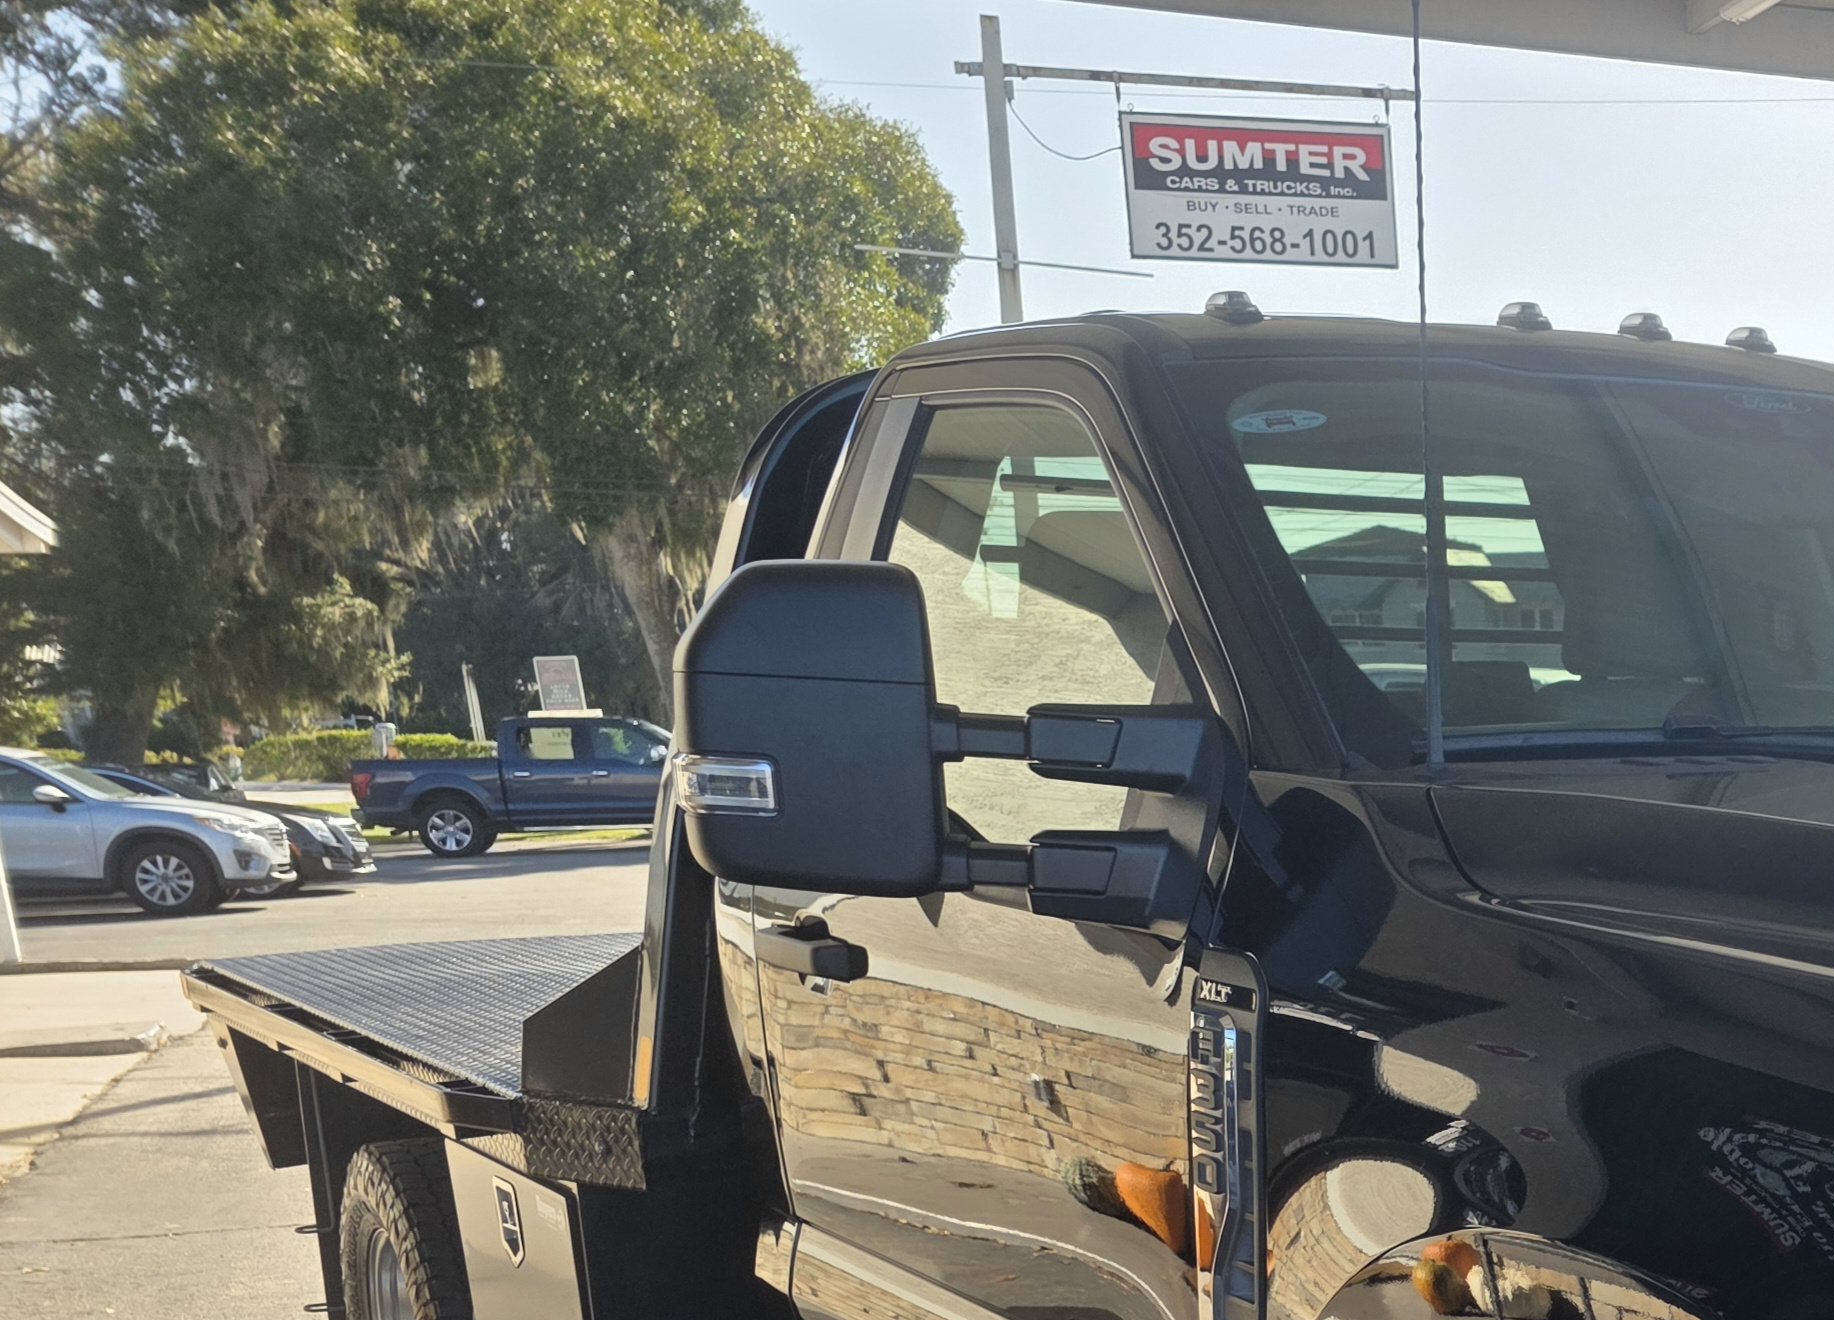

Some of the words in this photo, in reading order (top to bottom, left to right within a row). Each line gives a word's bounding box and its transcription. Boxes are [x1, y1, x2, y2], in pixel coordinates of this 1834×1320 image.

[1148, 136, 1371, 182] SUMTER
[1165, 175, 1220, 191] CARS
[1225, 178, 1240, 192] &
[1244, 179, 1327, 197] TRUCKS,
[1330, 185, 1357, 197] Inc.
[1186, 200, 1219, 213] BUY
[1233, 202, 1273, 216] SELL
[1286, 205, 1340, 218] TRADE
[1154, 222, 1377, 260] 352-568-1001
[1200, 979, 1230, 1003] XLT
[1708, 1165, 1802, 1249] SUMTER
